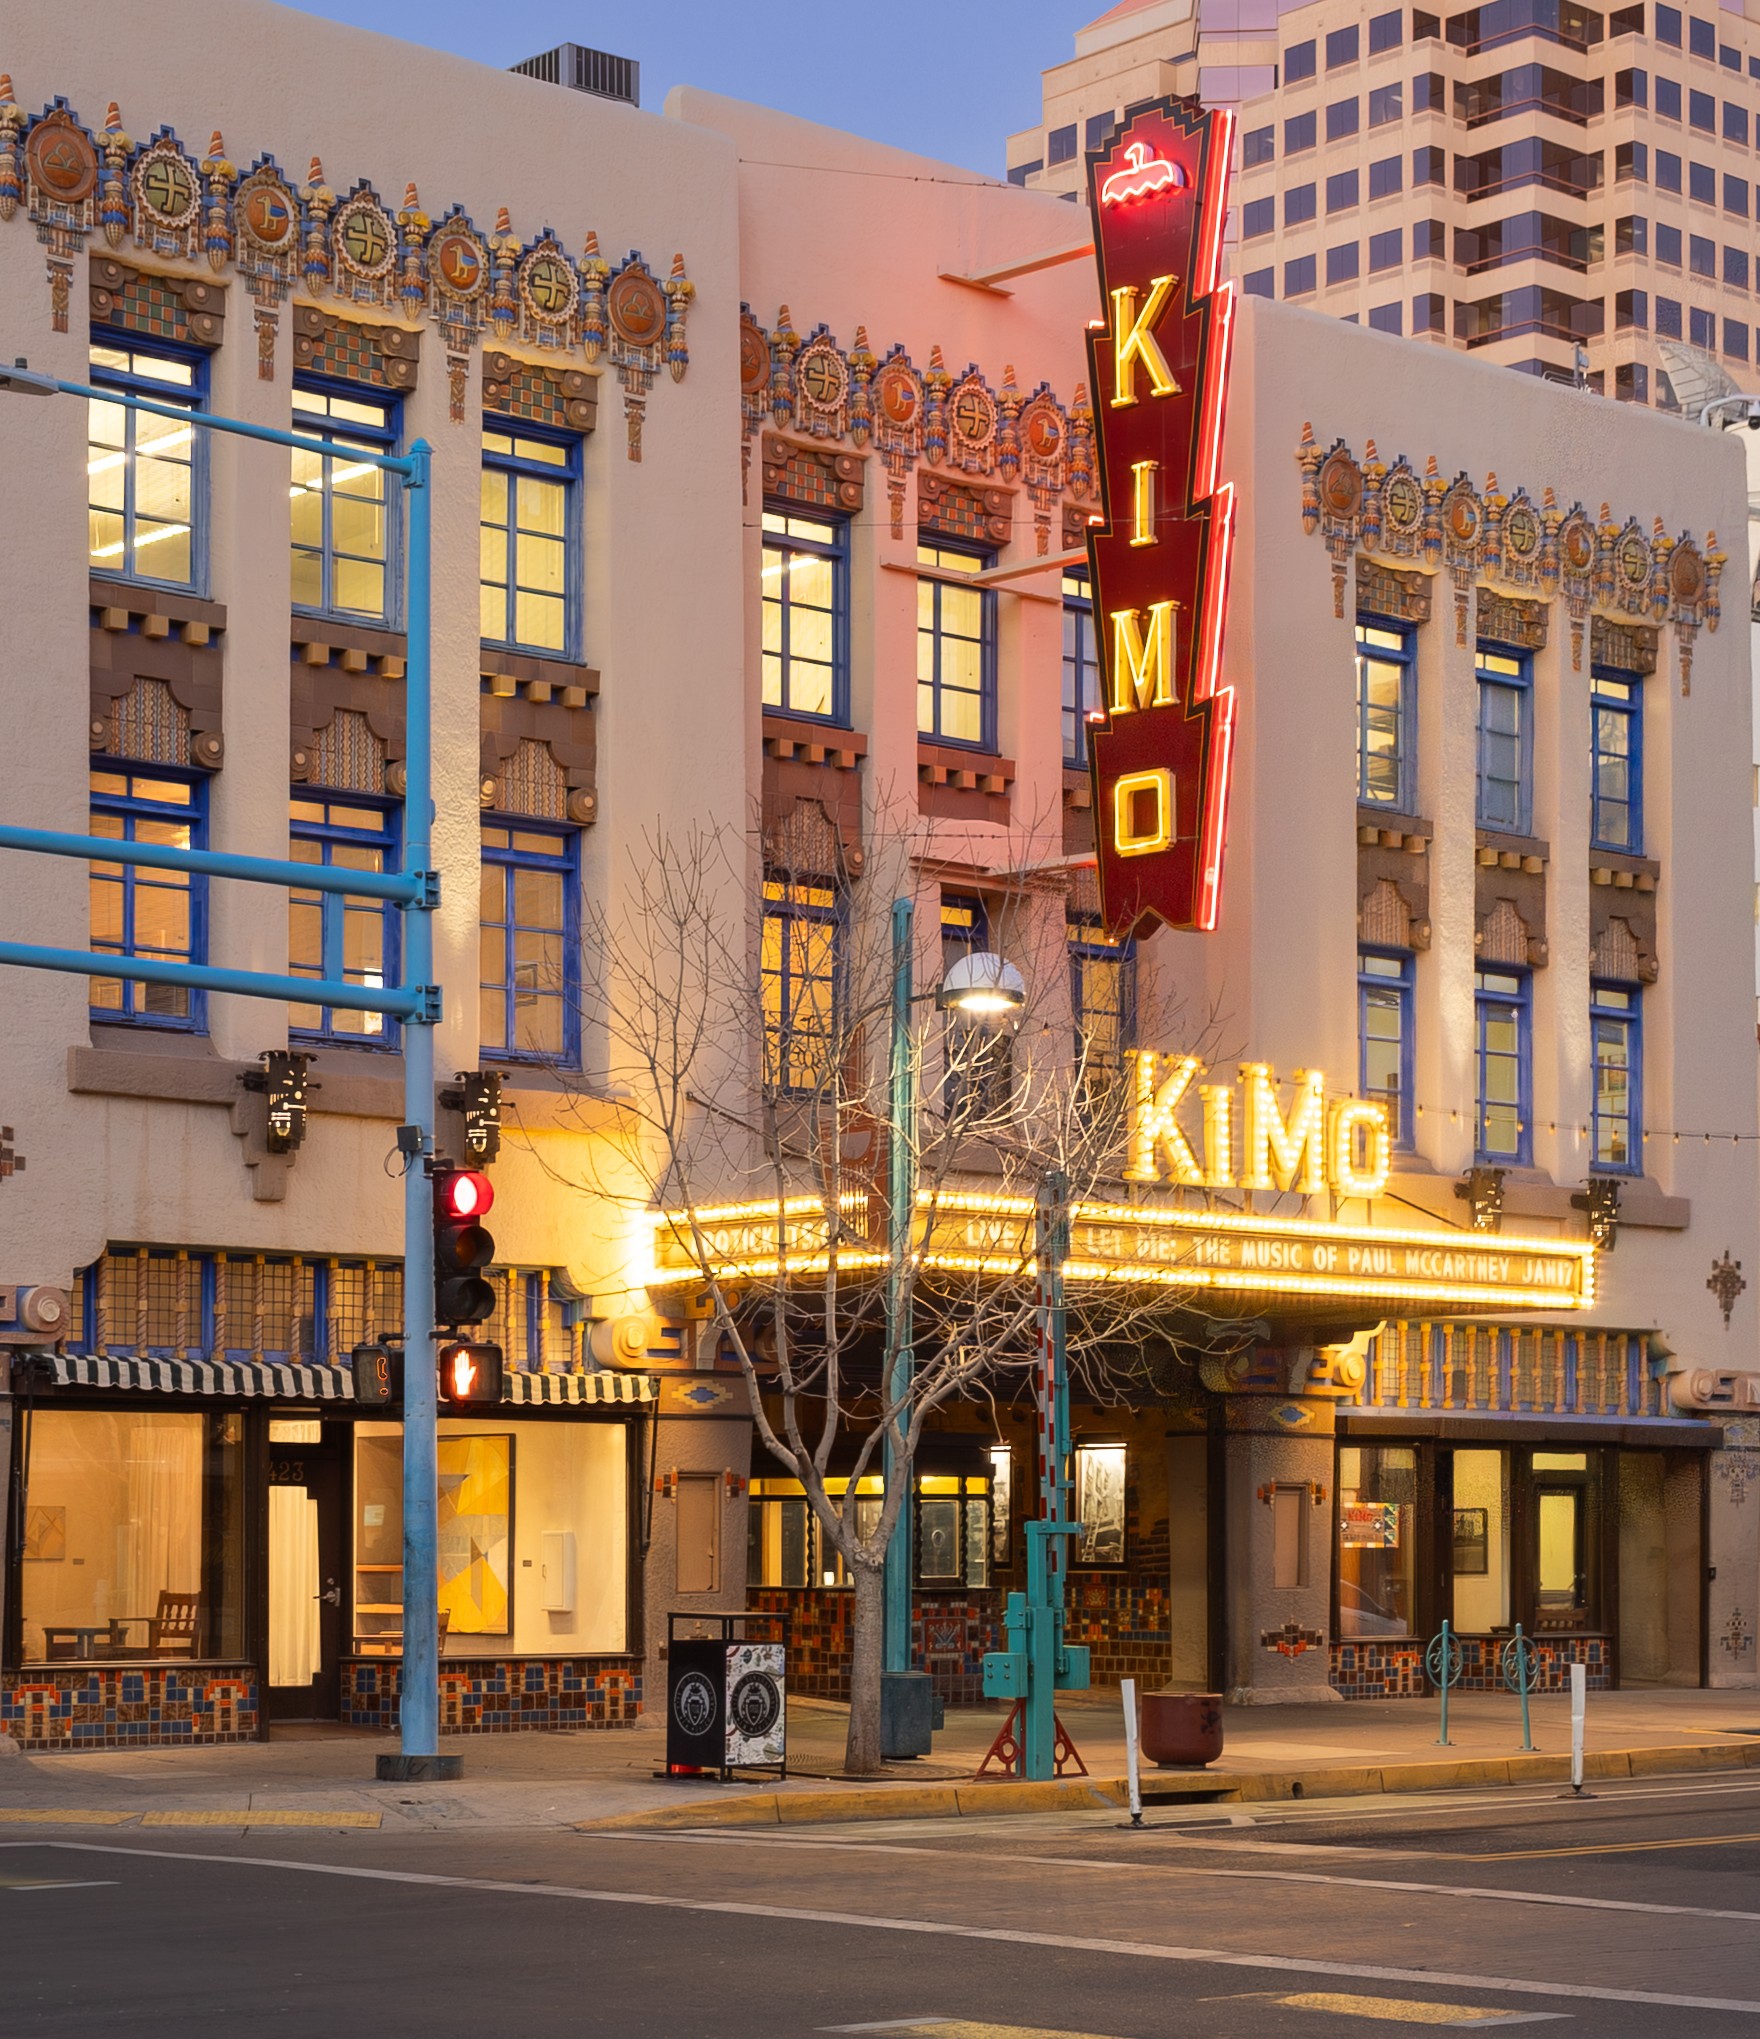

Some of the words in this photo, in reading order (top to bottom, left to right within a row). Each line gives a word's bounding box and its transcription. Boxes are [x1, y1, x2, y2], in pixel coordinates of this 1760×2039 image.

[1109, 273, 1183, 858] KIMO
[966, 1219, 1017, 1249] LIVE
[1087, 1227, 1124, 1257] LET
[1193, 1236, 1231, 1265] THE
[1241, 1240, 1303, 1269] MUSIC
[1313, 1244, 1338, 1271] OF
[1348, 1246, 1397, 1274] PAUL
[1405, 1250, 1510, 1281] MCCARTNEY
